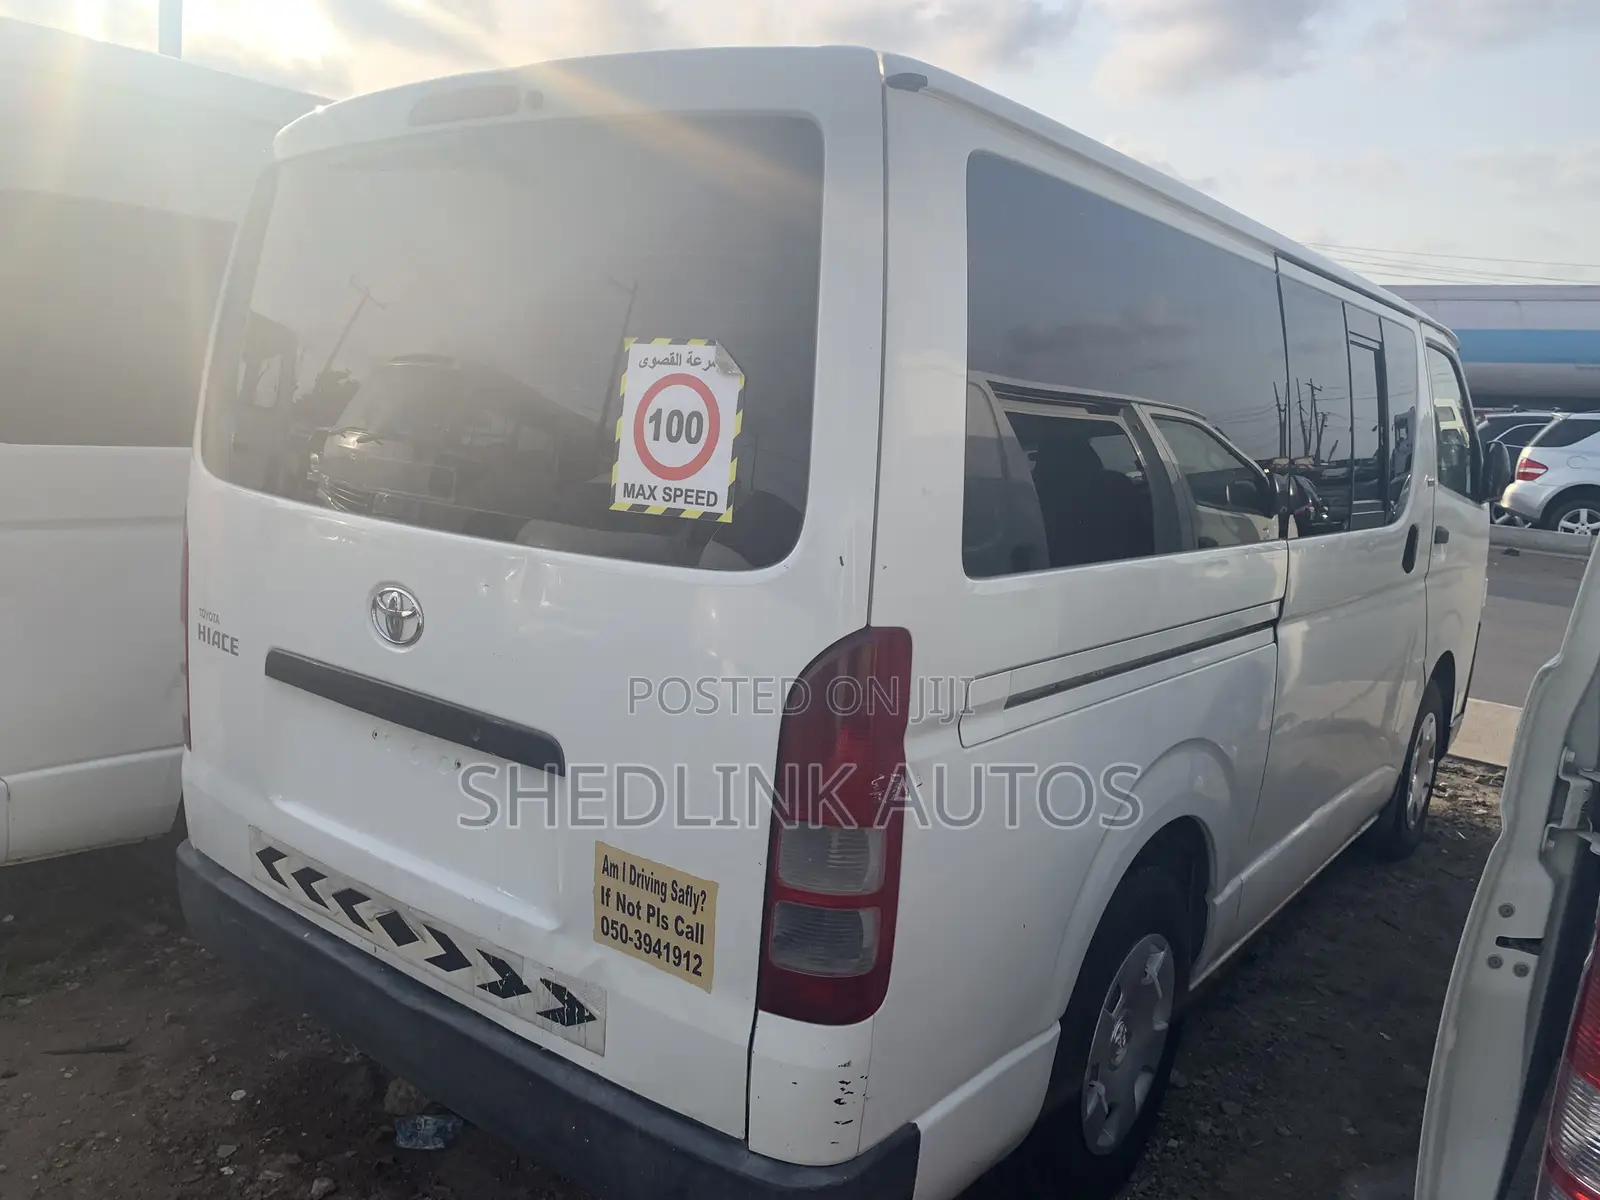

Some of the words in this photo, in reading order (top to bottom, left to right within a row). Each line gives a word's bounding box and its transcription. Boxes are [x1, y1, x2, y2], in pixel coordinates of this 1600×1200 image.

[638, 352, 682, 369] القصوى
[649, 408, 704, 445] 100
[623, 483, 658, 501] MAX
[662, 486, 718, 507] SPEED
[198, 608, 220, 624] TOYOTA
[198, 623, 239, 656] HIACE
[602, 855, 619, 880] Am
[629, 864, 667, 903] Driving
[671, 880, 707, 915] Safly?
[601, 886, 611, 907] If
[616, 892, 641, 920] Not
[647, 903, 669, 931] Pls
[674, 915, 705, 945] Call
[601, 916, 703, 977] 050-3941912
